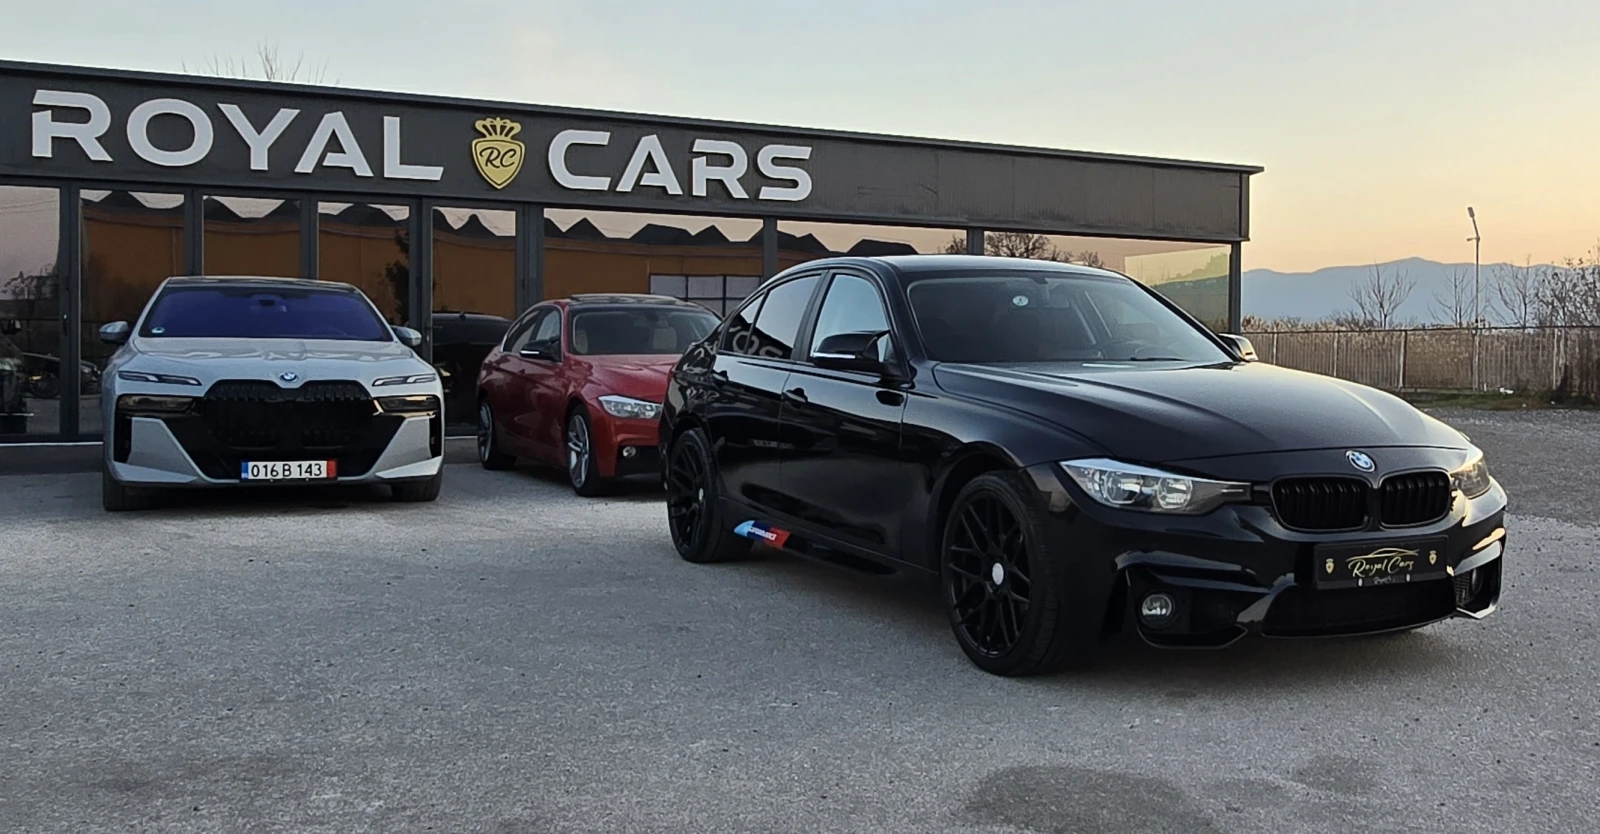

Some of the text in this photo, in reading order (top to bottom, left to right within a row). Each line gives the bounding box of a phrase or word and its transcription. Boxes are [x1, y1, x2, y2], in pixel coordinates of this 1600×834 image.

[32, 89, 812, 201] ROYAL CARS
[480, 147, 517, 169] RC
[1348, 556, 1415, 577] Royal Cars
